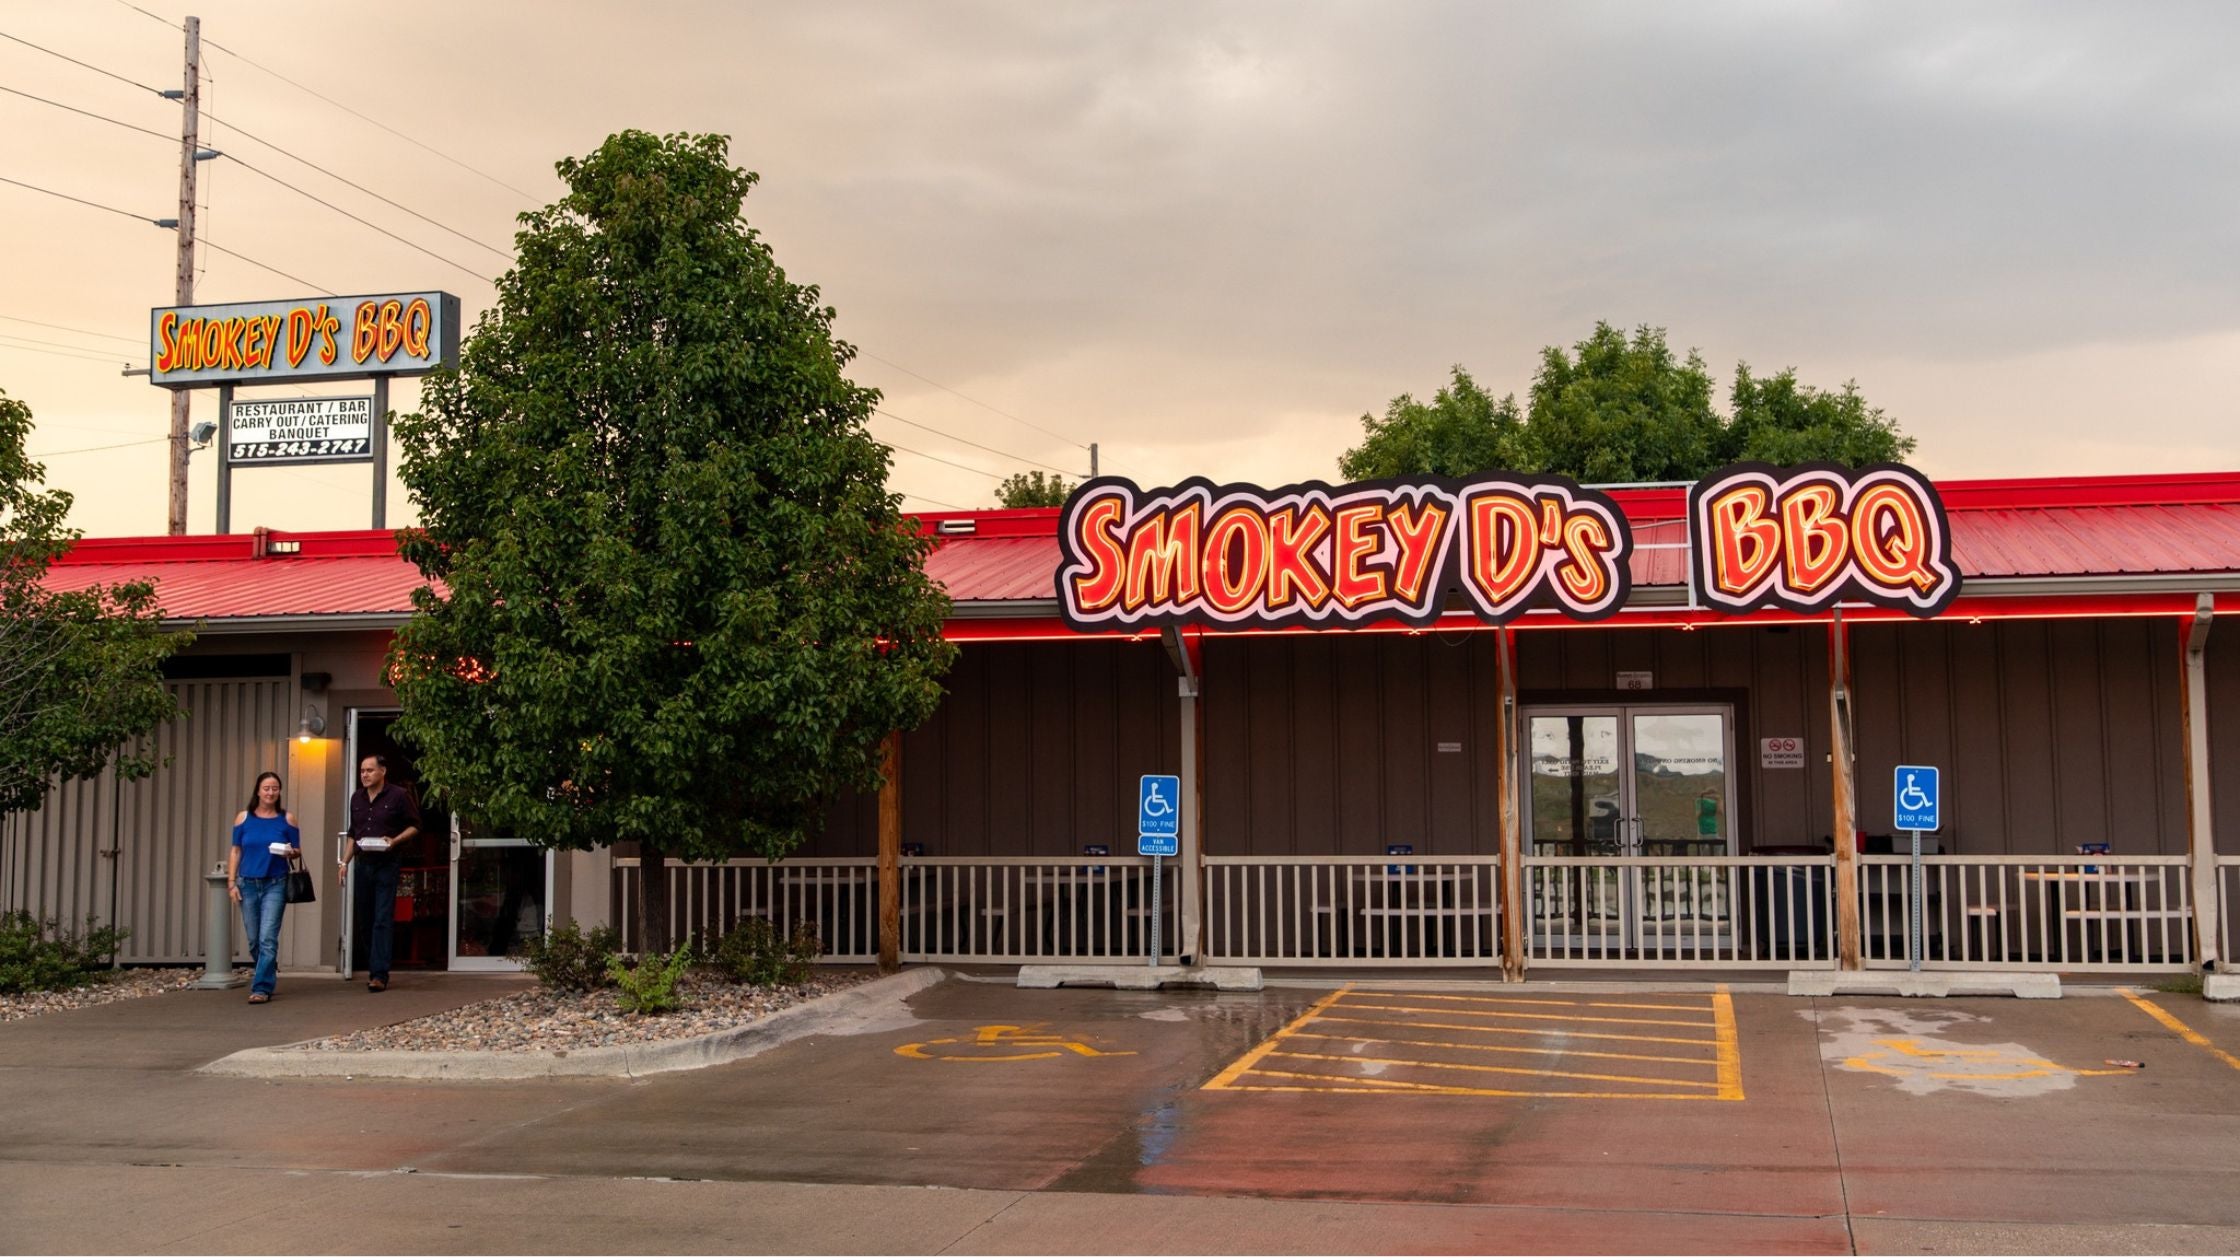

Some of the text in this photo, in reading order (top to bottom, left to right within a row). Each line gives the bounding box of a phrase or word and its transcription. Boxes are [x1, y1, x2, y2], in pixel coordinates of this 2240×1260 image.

[156, 310, 283, 374] SMOKEY
[351, 297, 432, 365] BBQ
[235, 402, 323, 417] RESTAURANT
[339, 400, 367, 413] BAR
[233, 417, 272, 430] CARRY
[269, 426, 330, 440] BANQUET
[233, 439, 367, 458] 515-243-2747
[1075, 497, 1447, 612] SMOKEY
[1712, 484, 1938, 594] BBQ
[1142, 820, 1175, 829] $100 FINE
[1898, 814, 1936, 823] $100 FINE
[1141, 844, 1174, 853] ACCESSIBLE
